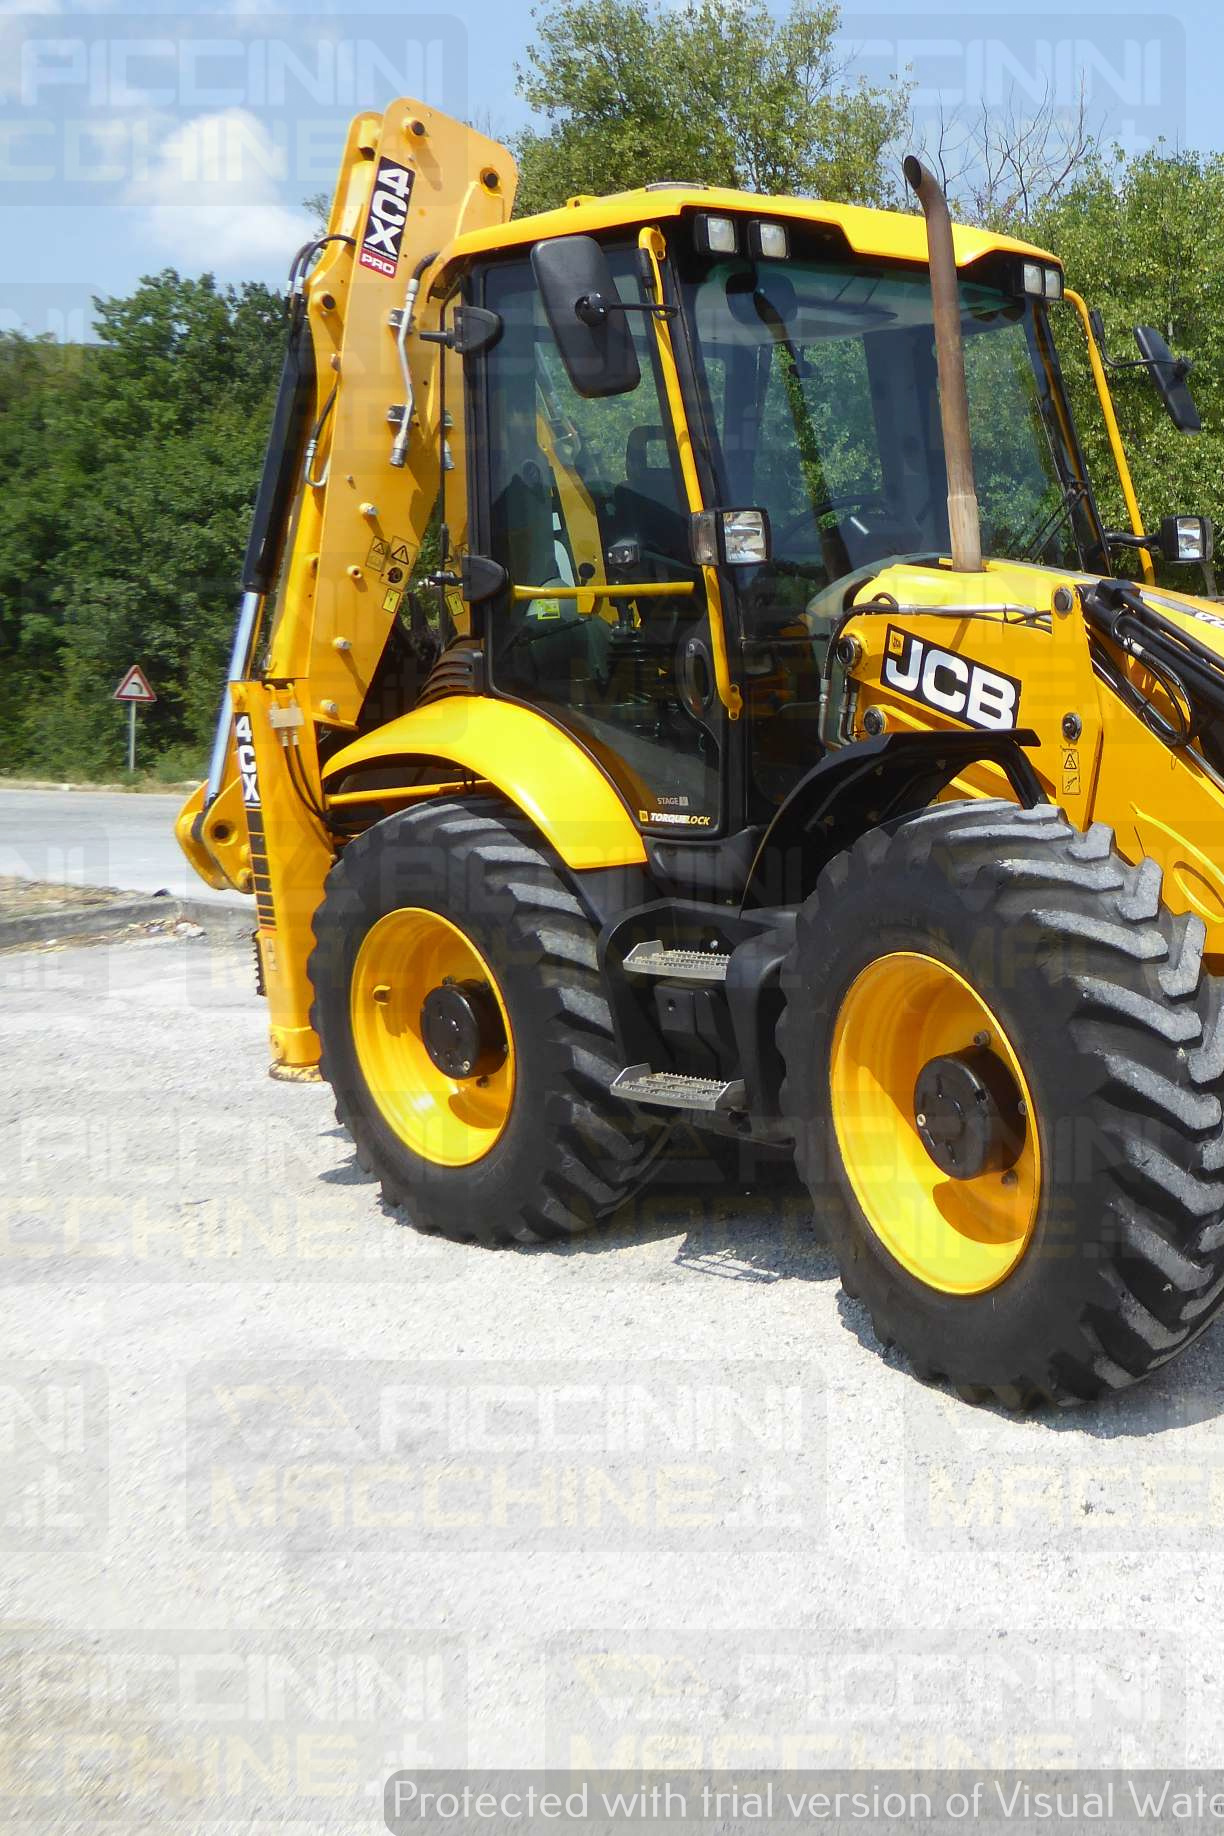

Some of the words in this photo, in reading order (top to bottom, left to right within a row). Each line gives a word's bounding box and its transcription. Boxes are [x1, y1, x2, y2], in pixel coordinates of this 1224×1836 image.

[365, 168, 410, 255] 4CX
[361, 253, 396, 274] PRO
[885, 639, 1016, 729] JCB
[236, 715, 260, 801] 4CX
